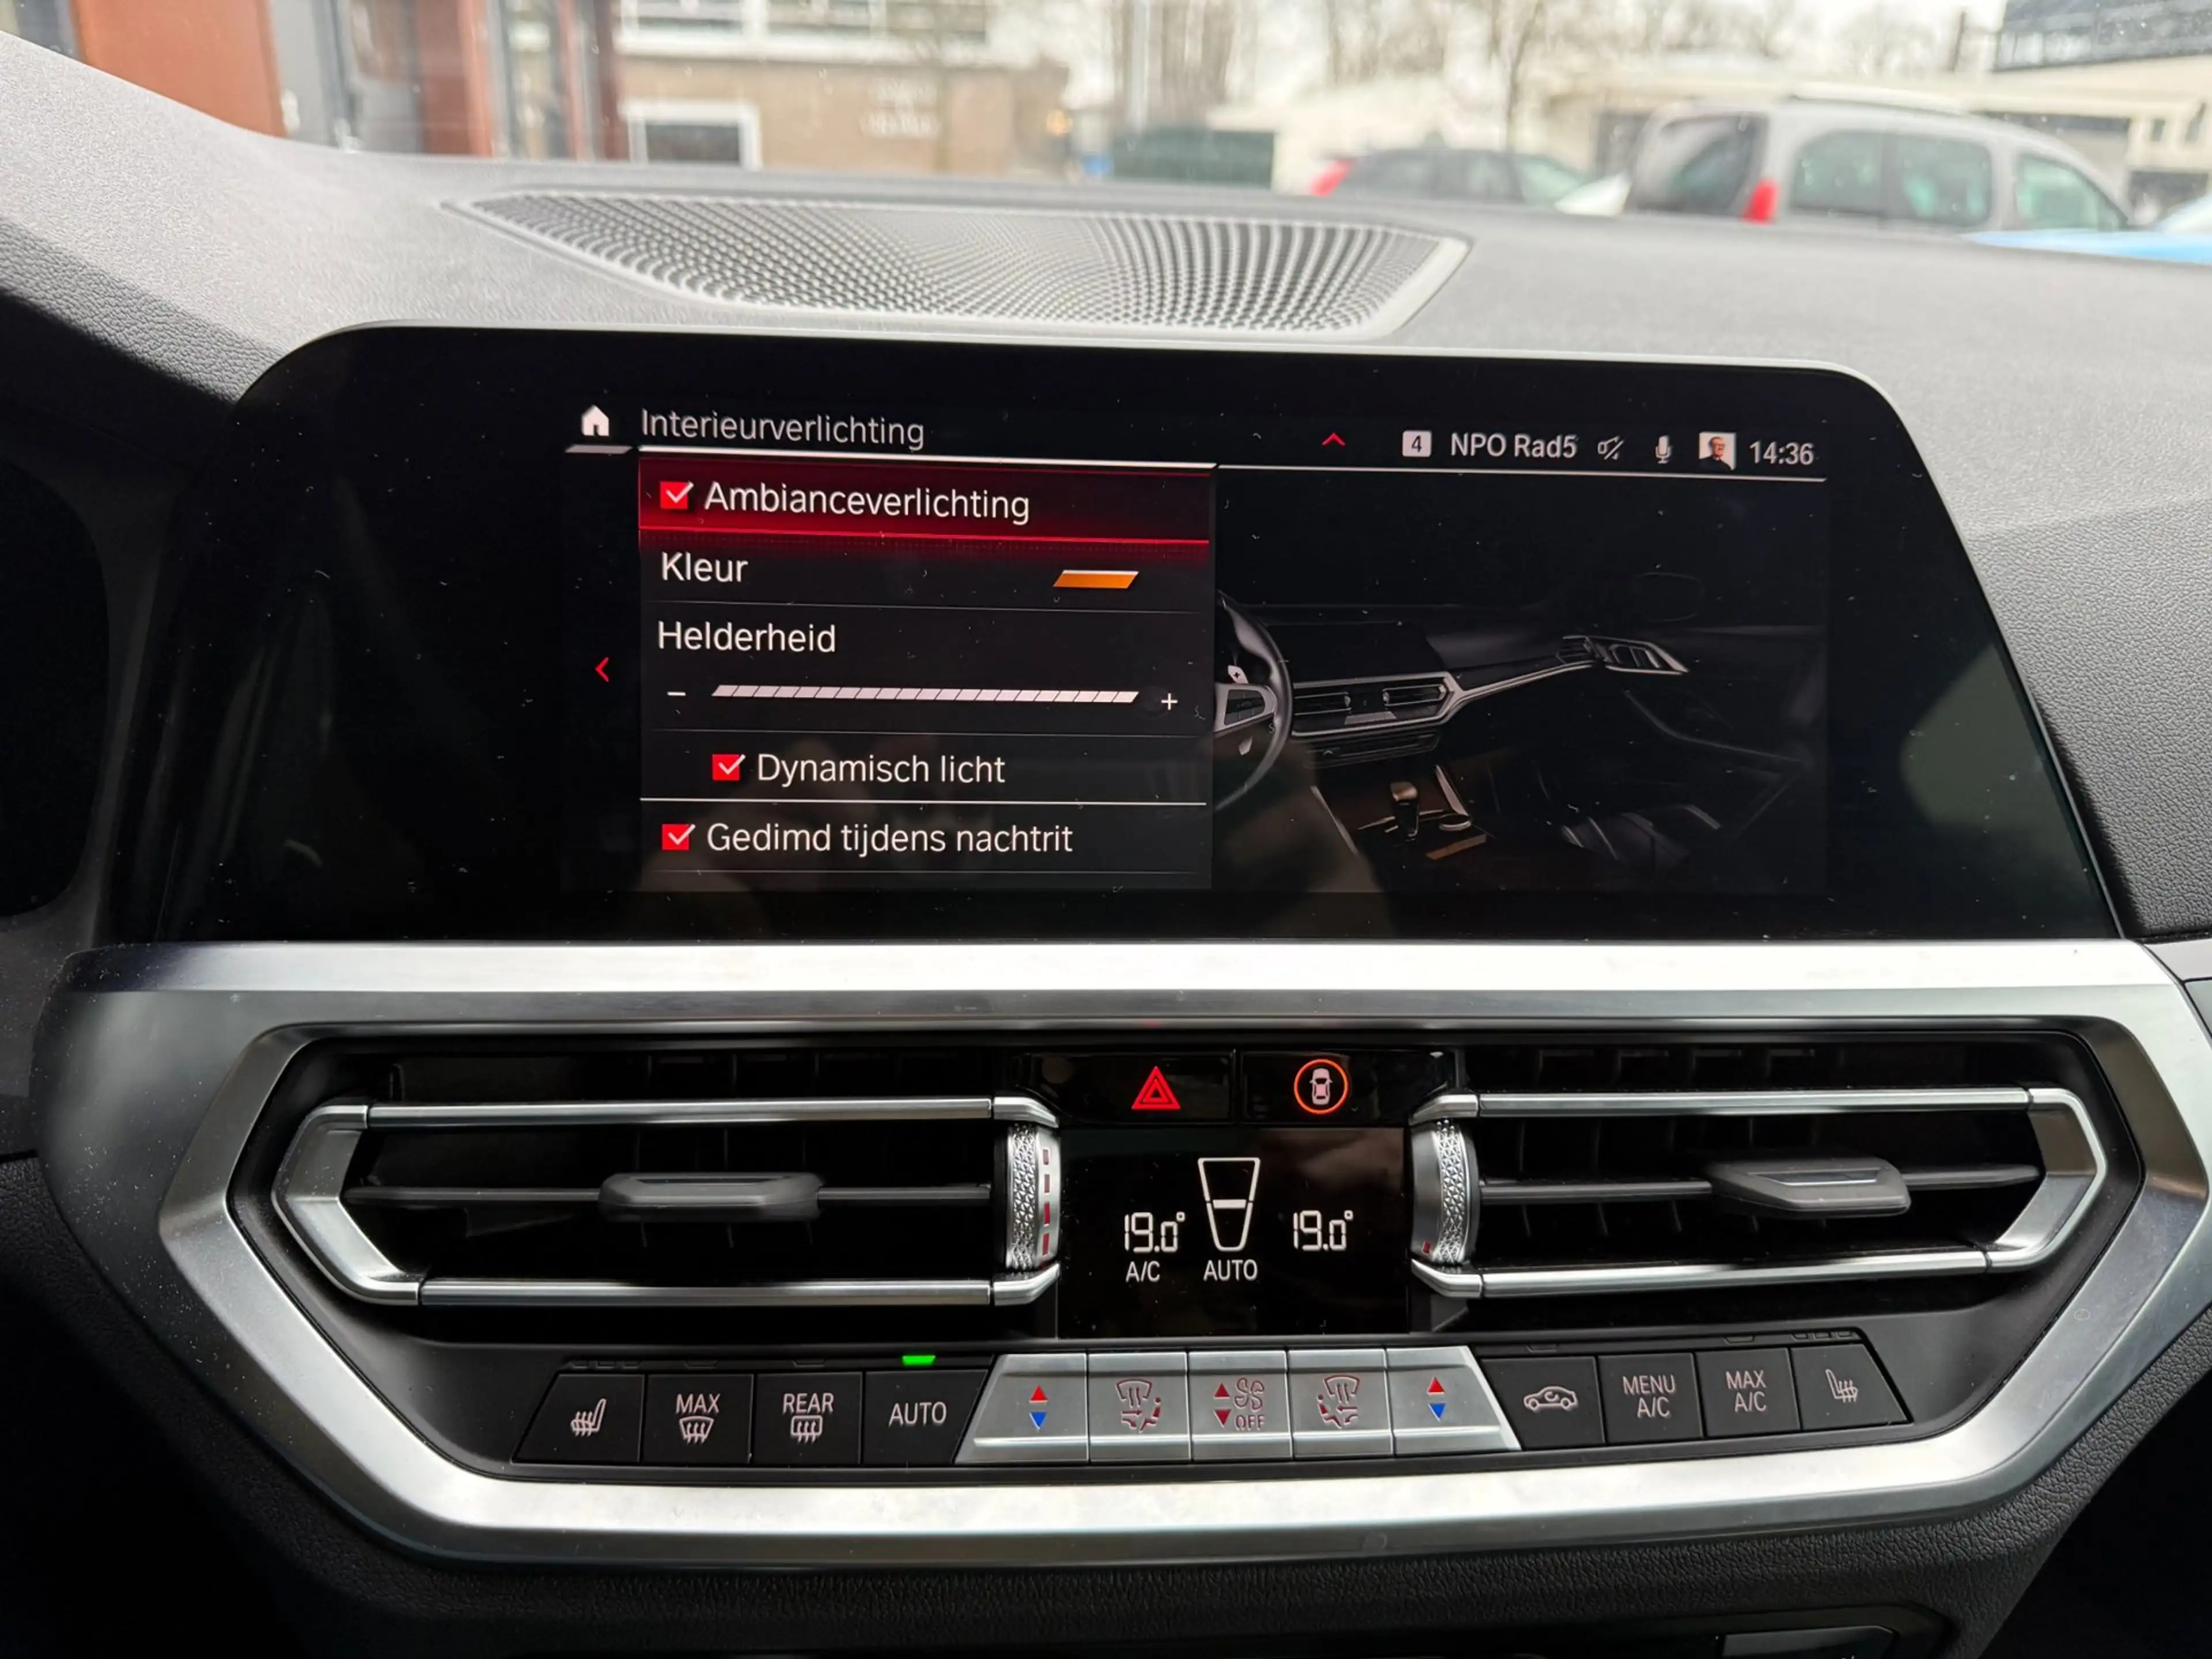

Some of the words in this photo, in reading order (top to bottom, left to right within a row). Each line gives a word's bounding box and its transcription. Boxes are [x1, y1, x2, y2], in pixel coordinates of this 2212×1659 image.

[641, 410, 925, 450] Interieurverlichting
[1411, 435, 1422, 453] 4
[1451, 433, 1506, 457] NPO
[1514, 434, 1577, 459] Rad5
[1749, 441, 1815, 465] 14:36
[704, 482, 1029, 525] Ambianceverlichting
[662, 551, 748, 582] Kleur
[658, 620, 836, 653] Helderheid
[758, 753, 929, 787] Dynamisch
[941, 755, 1006, 783] licht
[707, 823, 831, 851] Gedimd
[841, 824, 946, 858] tijdens
[957, 824, 1073, 853] nachtrit
[1126, 1260, 1161, 1282] A/C
[1203, 1259, 1258, 1281] AUTO
[1623, 1374, 1676, 1395] MENU
[1726, 1370, 1767, 1389] MAX
[676, 1393, 721, 1414] MAX
[783, 1392, 834, 1413] REAR
[1637, 1396, 1671, 1418] A/C
[1735, 1391, 1767, 1412] A/C
[889, 1402, 947, 1426] AUTO
[1235, 1415, 1265, 1429] OFF
